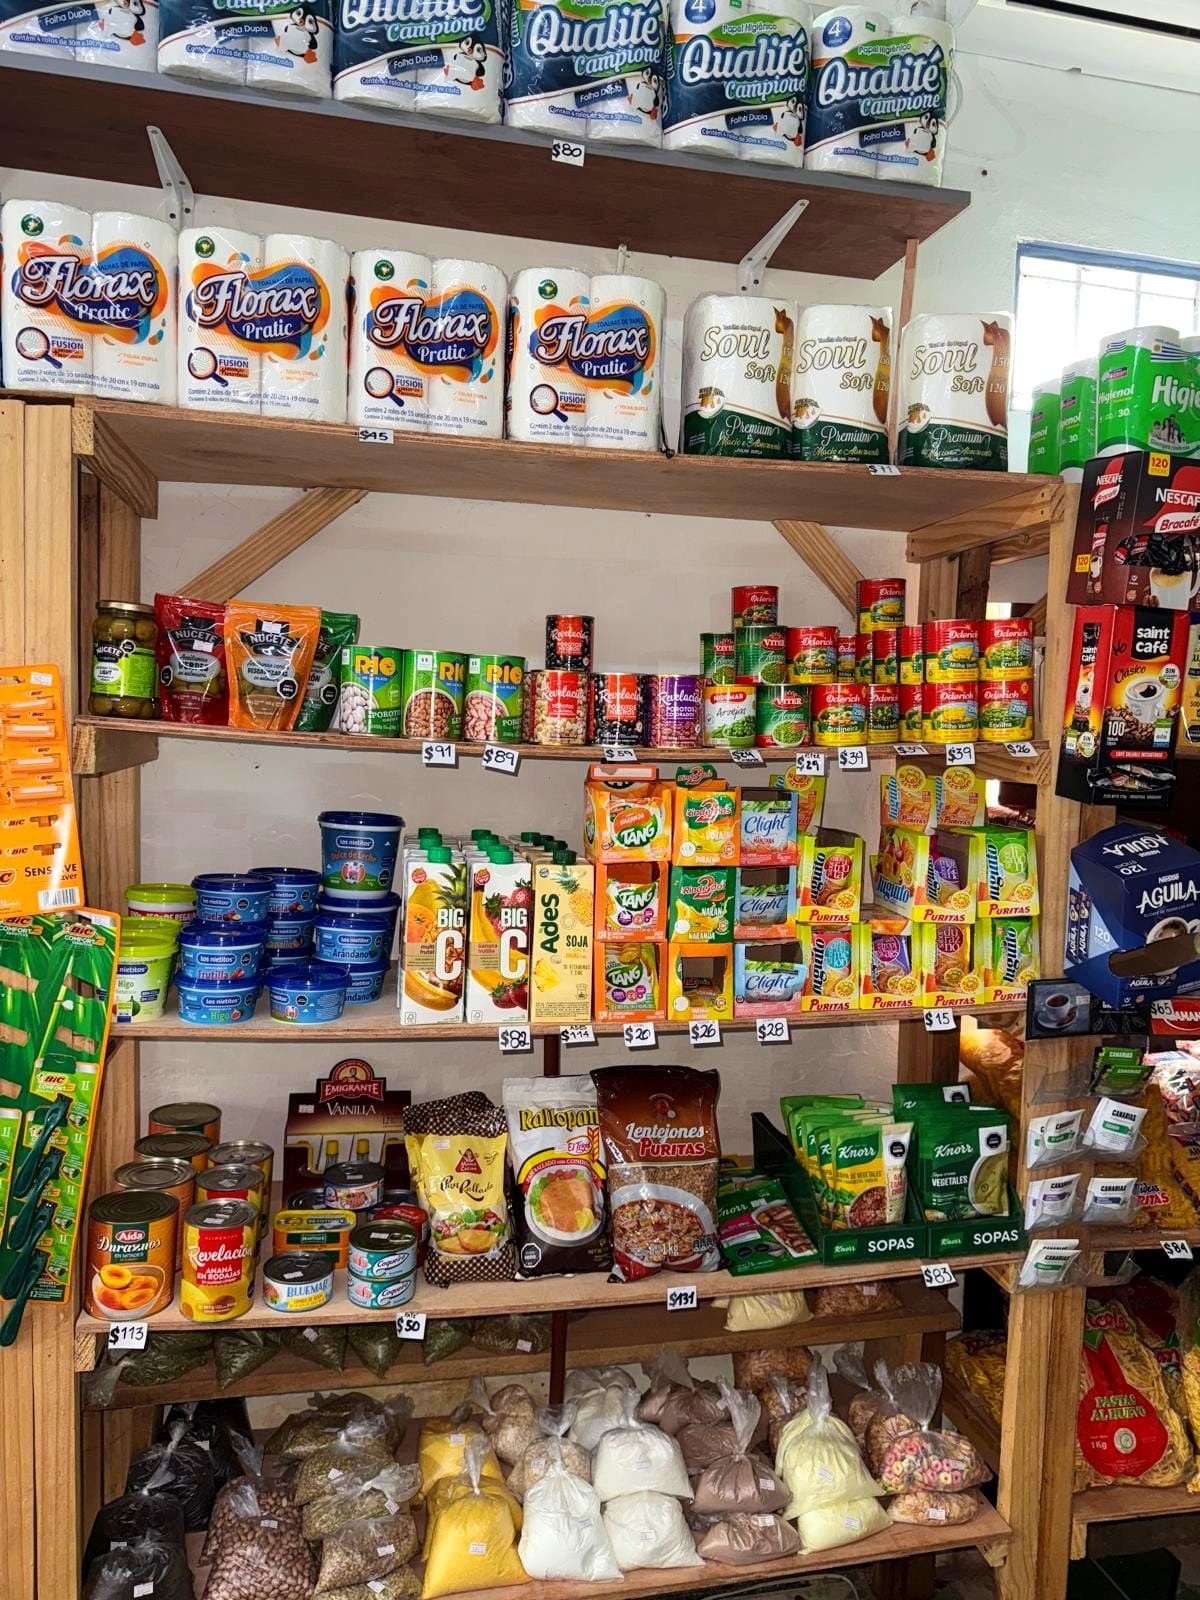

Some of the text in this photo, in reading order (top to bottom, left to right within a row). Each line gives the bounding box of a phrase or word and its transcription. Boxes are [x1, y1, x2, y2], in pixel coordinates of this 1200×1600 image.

[44, 9, 92, 26] Folha Dupla
[221, 24, 269, 36] Folha Dupla
[386, 16, 487, 42] Campione
[530, 2, 662, 56] Qualité
[723, 25, 744, 35] Papel
[828, 21, 842, 37] 4
[681, 29, 806, 83] Qualité
[859, 46, 880, 55] Papel
[394, 55, 438, 70] Folha Dupla
[574, 46, 662, 76] Campione
[819, 47, 943, 106] Qualité
[725, 77, 806, 101] Campione
[580, 91, 601, 103] Folha
[860, 92, 941, 117] Campione
[730, 113, 769, 125] Folha Dupla
[552, 143, 583, 159] $80
[22, 255, 154, 303] Florax
[196, 273, 319, 321] Florax
[75, 303, 132, 321] Pratic
[371, 299, 487, 344] Florax
[243, 319, 294, 340] Pratic
[51, 340, 84, 350] FUSION
[536, 316, 648, 360] Florax
[701, 326, 771, 362] Soul
[418, 345, 466, 363] Pratic
[796, 339, 868, 374] Soul
[911, 342, 978, 380] Soul
[219, 358, 249, 369] FUSION
[582, 360, 628, 376] Pratic
[744, 362, 776, 383] Soft
[396, 378, 424, 389] FUSION
[839, 371, 873, 392] Soft
[951, 376, 985, 395] Soft
[560, 396, 586, 404] FUSION
[1117, 408, 1131, 419] 30
[725, 415, 780, 437] Premium
[360, 430, 389, 441] $45
[820, 425, 879, 449] Premium
[1150, 457, 1169, 469] 120
[1077, 557, 1089, 567] 120
[174, 628, 219, 644] NUCETE
[249, 633, 293, 648] NUCETE
[993, 628, 1029, 638] Oderich
[1136, 626, 1170, 641] saint
[801, 636, 833, 646] Oderich
[1135, 640, 1169, 655] café
[1081, 646, 1098, 654] saint
[353, 654, 396, 677] RIO
[1000, 660, 1023, 668] Ervilha
[1081, 653, 1096, 663] café
[485, 663, 523, 686] RIO
[1114, 663, 1146, 684] Clásico
[1164, 667, 1176, 675] SIN
[775, 697, 803, 706] VITER
[825, 693, 860, 704] Oderich
[940, 691, 974, 702] Oderich
[984, 690, 1019, 700] Oderich
[827, 725, 858, 734] Jardineira
[988, 721, 1012, 729] Ervilha
[1107, 720, 1126, 737] 100
[423, 745, 452, 761] $91
[605, 749, 634, 759] $59
[947, 746, 972, 763] $39
[1006, 744, 1031, 754] $26
[483, 747, 515, 767] $89
[839, 751, 864, 767] $39
[8, 818, 26, 827] BIC
[743, 813, 789, 837] Clight
[901, 814, 927, 825] PURITAS
[943, 815, 972, 826] PURITAS
[621, 822, 655, 846] TANG
[12, 847, 30, 856] BIC
[1102, 833, 1170, 857] AGUILA
[1119, 863, 1148, 876] 120
[618, 891, 653, 909] TANG
[1135, 879, 1200, 915] AGUILA
[739, 896, 785, 914] Clight
[988, 902, 1031, 916] PURITAS
[436, 908, 465, 928] BIG
[500, 908, 528, 928] BIG
[809, 908, 850, 923] PURITAS
[923, 908, 966, 923] PURITAS
[70, 926, 95, 936] BIC
[540, 893, 560, 954] Ades
[1094, 924, 1111, 944] 120
[566, 935, 588, 949] SOJA
[209, 955, 234, 964] nietitos
[332, 948, 369, 960] Arándano
[435, 929, 463, 982] C
[499, 929, 527, 980] C
[119, 965, 146, 974] nietitos
[608, 965, 641, 986] TANG
[117, 980, 134, 990] Higo
[744, 974, 794, 993] Clight
[1128, 978, 1154, 988] AGUILA
[213, 997, 238, 1006] nietitos
[809, 998, 850, 1011] PURITAS
[872, 996, 913, 1009] PURITAS
[934, 994, 976, 1007] PURITAS
[1151, 999, 1173, 1016] $65
[210, 1010, 229, 1022] Higo
[924, 1010, 951, 1027] $15
[500, 1029, 529, 1049] $82
[561, 1028, 589, 1043] $114
[691, 1023, 716, 1041] $26
[758, 1022, 784, 1041] $28
[1109, 1050, 1133, 1058] CANARIAS
[325, 1082, 380, 1097] EMIGRANTE
[326, 1101, 377, 1117] VAINILLA
[1111, 1109, 1137, 1122] CANARIAS
[519, 1107, 600, 1132] Rallopan
[625, 1122, 704, 1140] Lentejones
[639, 1137, 706, 1157] PURITAS
[838, 1145, 877, 1158] Knorr
[934, 1143, 974, 1158] Knorr
[856, 1170, 882, 1179] VEGETALES
[932, 1175, 969, 1187] VEGETALES
[459, 1178, 494, 1202] Rallado
[1100, 1184, 1127, 1192] CANARIAS
[867, 1237, 915, 1252] SOPAS
[941, 1237, 962, 1246] Knorr
[973, 1229, 1019, 1245] SOPAS
[834, 1244, 857, 1255] Knorr
[1164, 1241, 1188, 1255] $84
[196, 1271, 241, 1281] EN RODAJAS
[204, 1265, 233, 1275] ANANÁ
[924, 1268, 953, 1285] $83
[286, 1279, 329, 1298] BLUEMAR
[669, 1290, 695, 1309] $131
[397, 1317, 421, 1333] $50
[108, 1325, 145, 1346] $113
[1094, 1394, 1137, 1408] PASTAS
[1090, 1405, 1146, 1421] AL HUEVO
[1091, 1440, 1108, 1450] 1Kg
